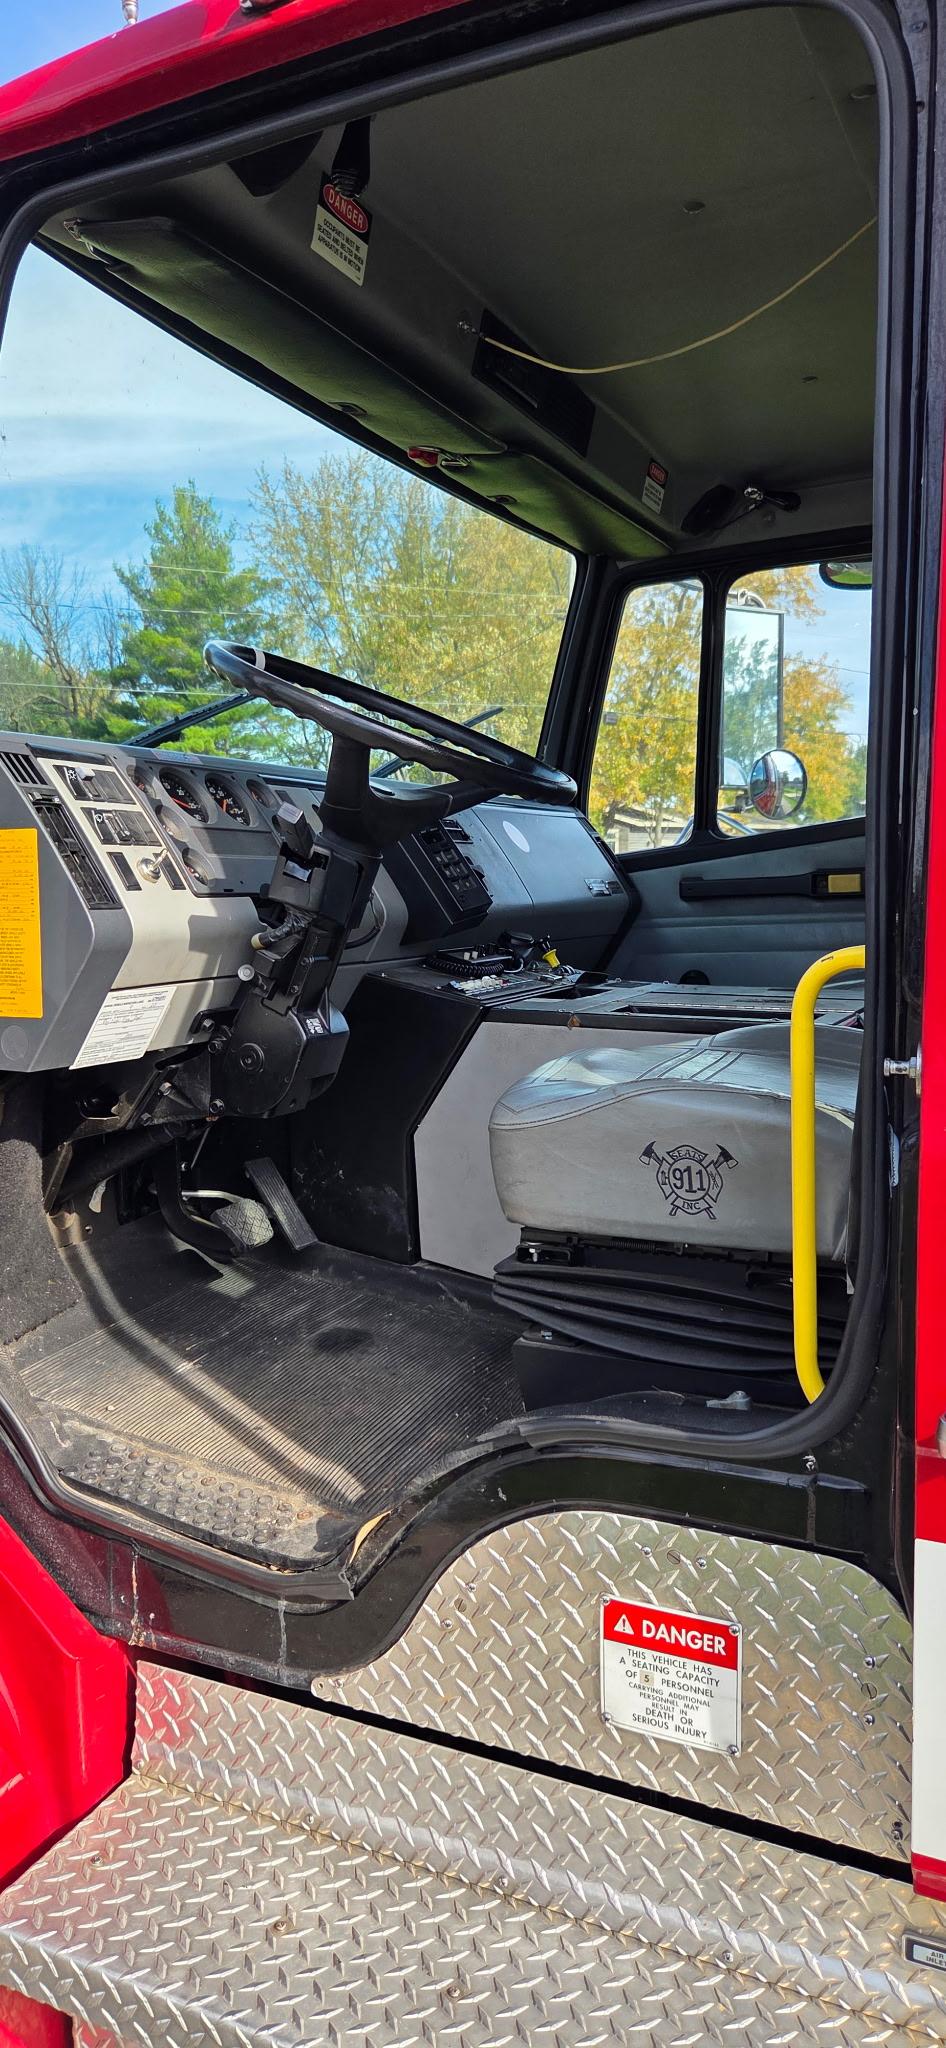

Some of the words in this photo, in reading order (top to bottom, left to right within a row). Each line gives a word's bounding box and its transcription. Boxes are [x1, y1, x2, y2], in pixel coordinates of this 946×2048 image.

[328, 189, 363, 228] DANGER
[332, 235, 340, 246] AND
[672, 1150, 704, 1161] SEATS
[673, 1166, 706, 1194] 911
[682, 1201, 701, 1209] INC
[642, 1620, 726, 1656] DANGER
[619, 1657, 626, 1665] A
[632, 1660, 670, 1675] SEATING
[676, 1670, 720, 1687] CAPACITY
[628, 1649, 645, 1659] THIS
[652, 1655, 687, 1670] VEHICLE
[693, 1665, 712, 1675] HAS
[625, 1670, 637, 1679] OF
[644, 1674, 650, 1683] 5
[662, 1678, 714, 1698] PERSONNEL
[629, 1682, 663, 1696] CARRYING
[668, 1692, 711, 1707] ADDITIONAL
[640, 1693, 679, 1706] PERSONNEL
[684, 1704, 699, 1712] MAY
[652, 1702, 675, 1712] RESULT
[632, 1713, 669, 1730] SERIOUS
[675, 1724, 707, 1738] INJURY
[645, 1708, 674, 1721] DEATH
[680, 1716, 693, 1726] OR
